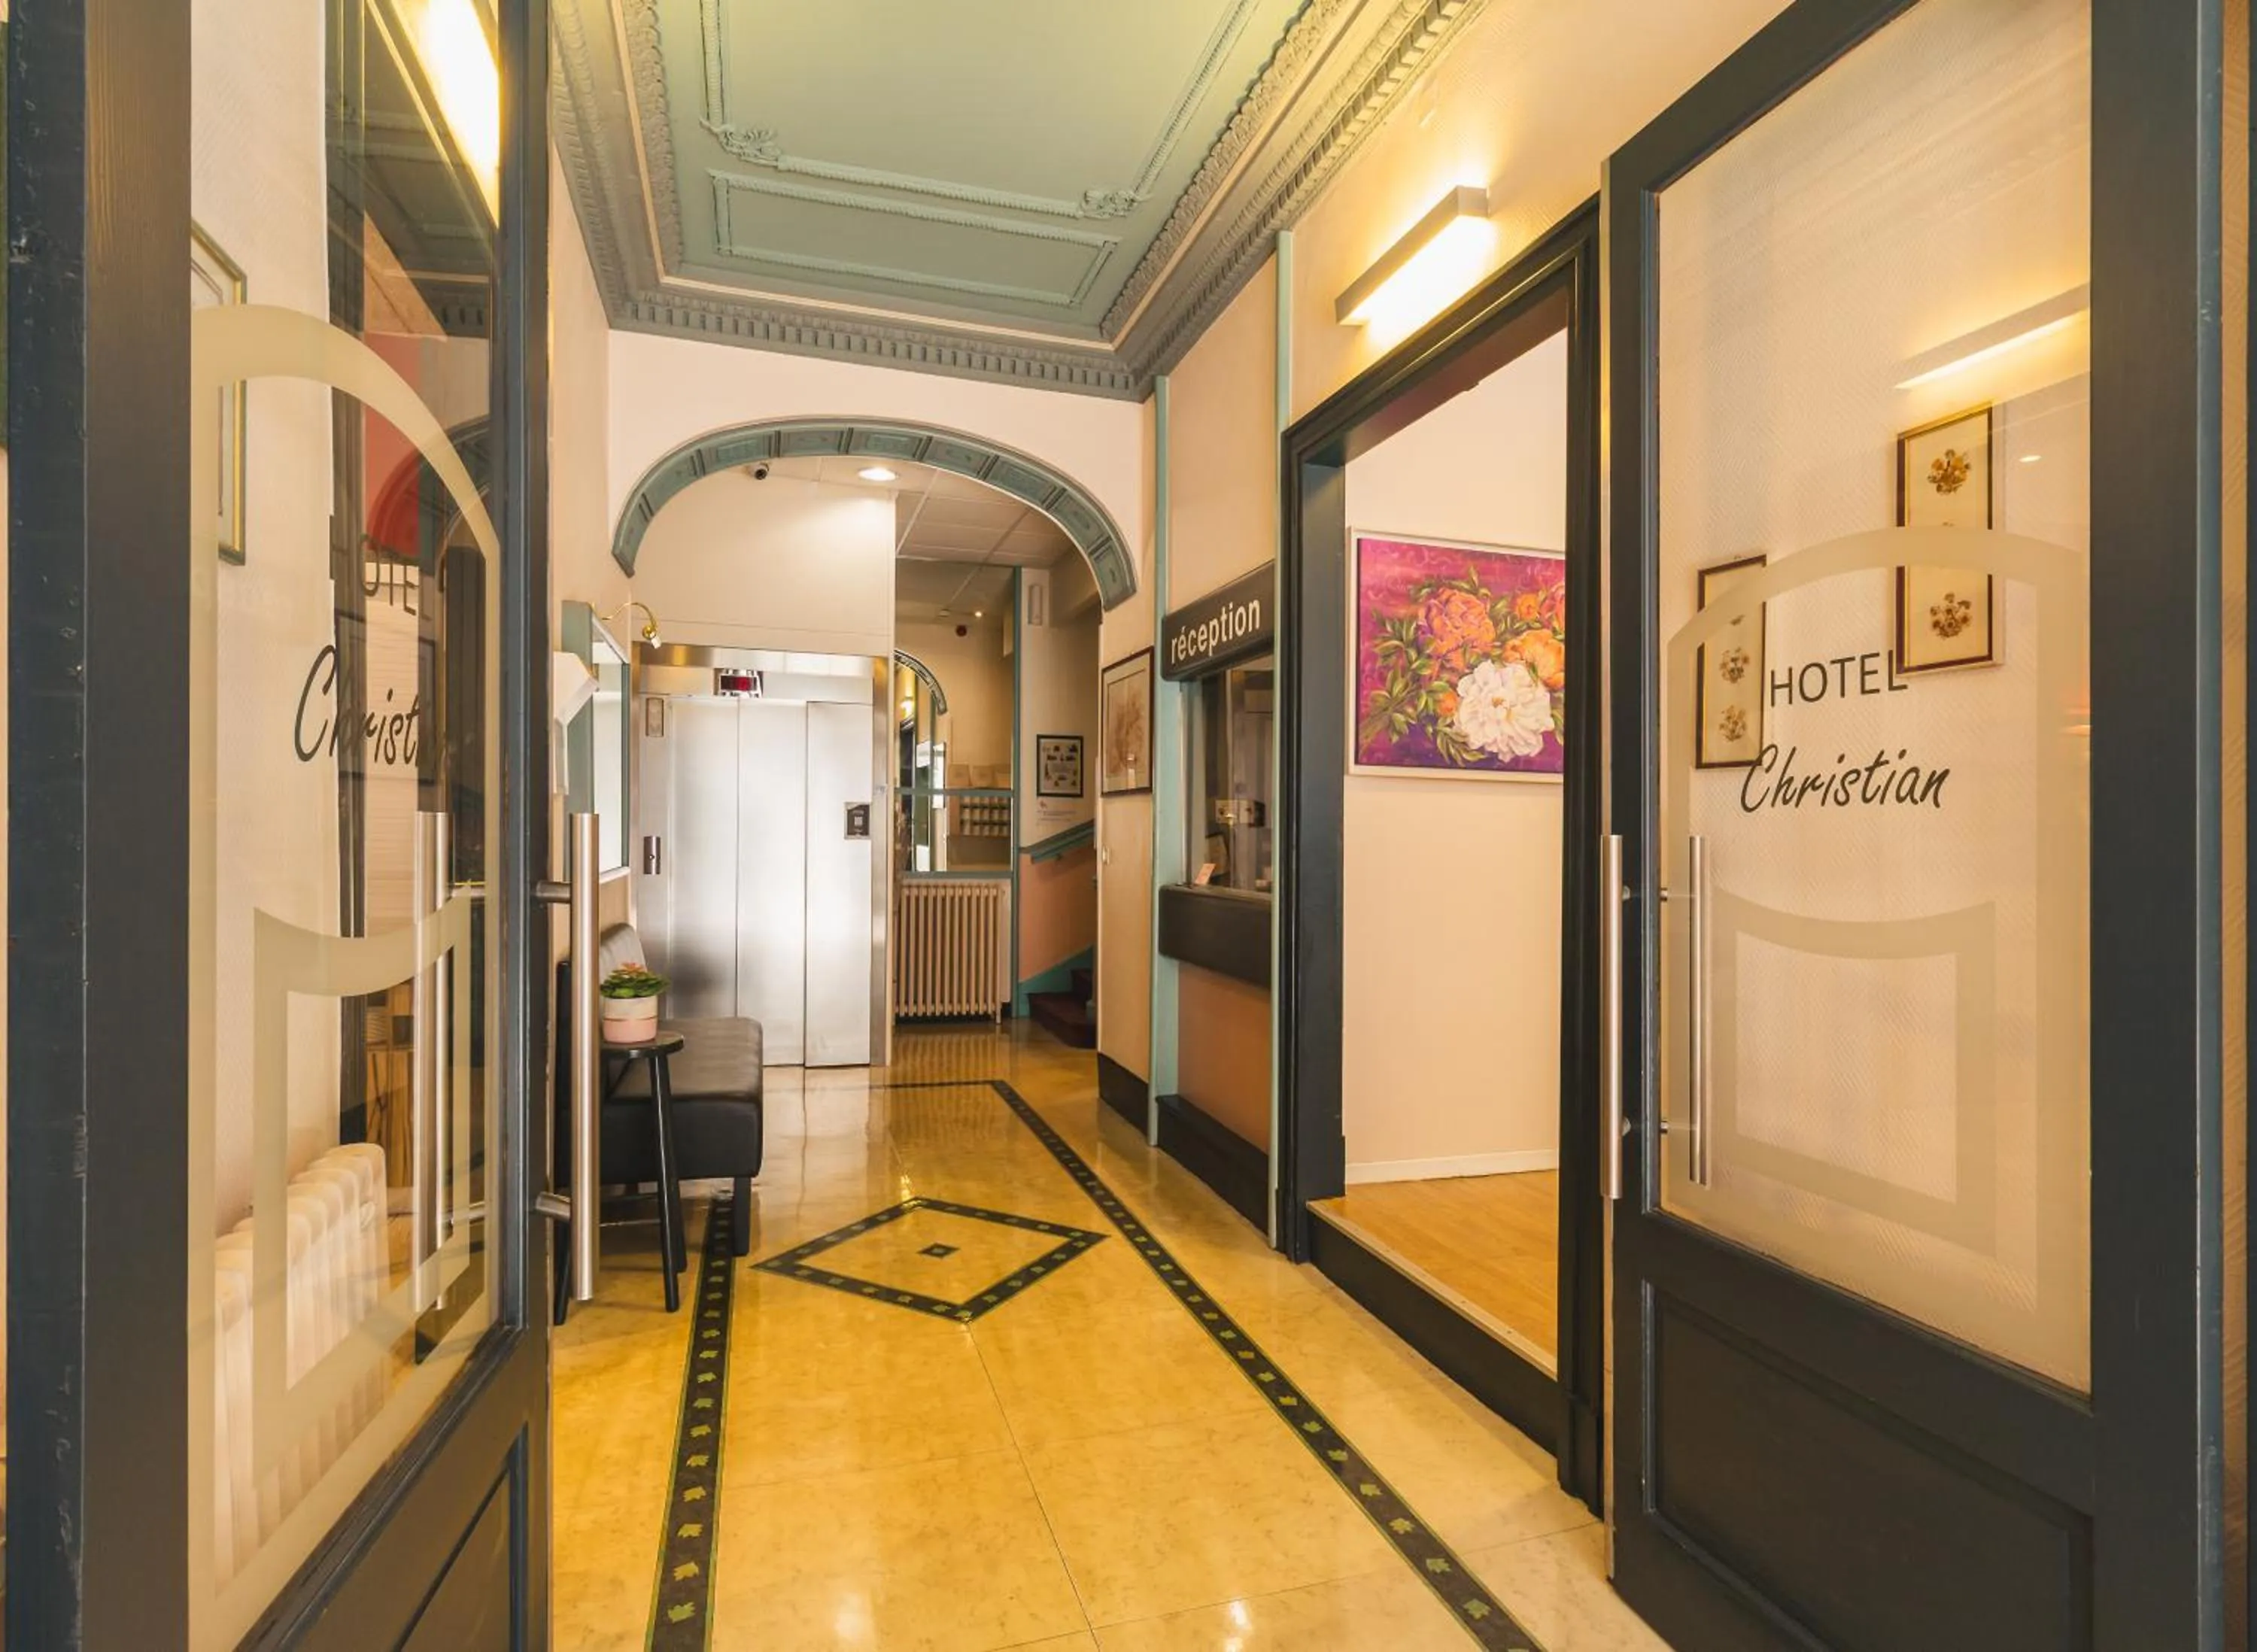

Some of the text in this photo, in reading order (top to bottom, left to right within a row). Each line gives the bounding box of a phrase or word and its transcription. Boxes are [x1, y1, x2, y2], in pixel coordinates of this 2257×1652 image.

[1171, 599, 1260, 664] réception
[1770, 650, 1908, 707] HOTEL
[1740, 743, 1951, 813] Christian
